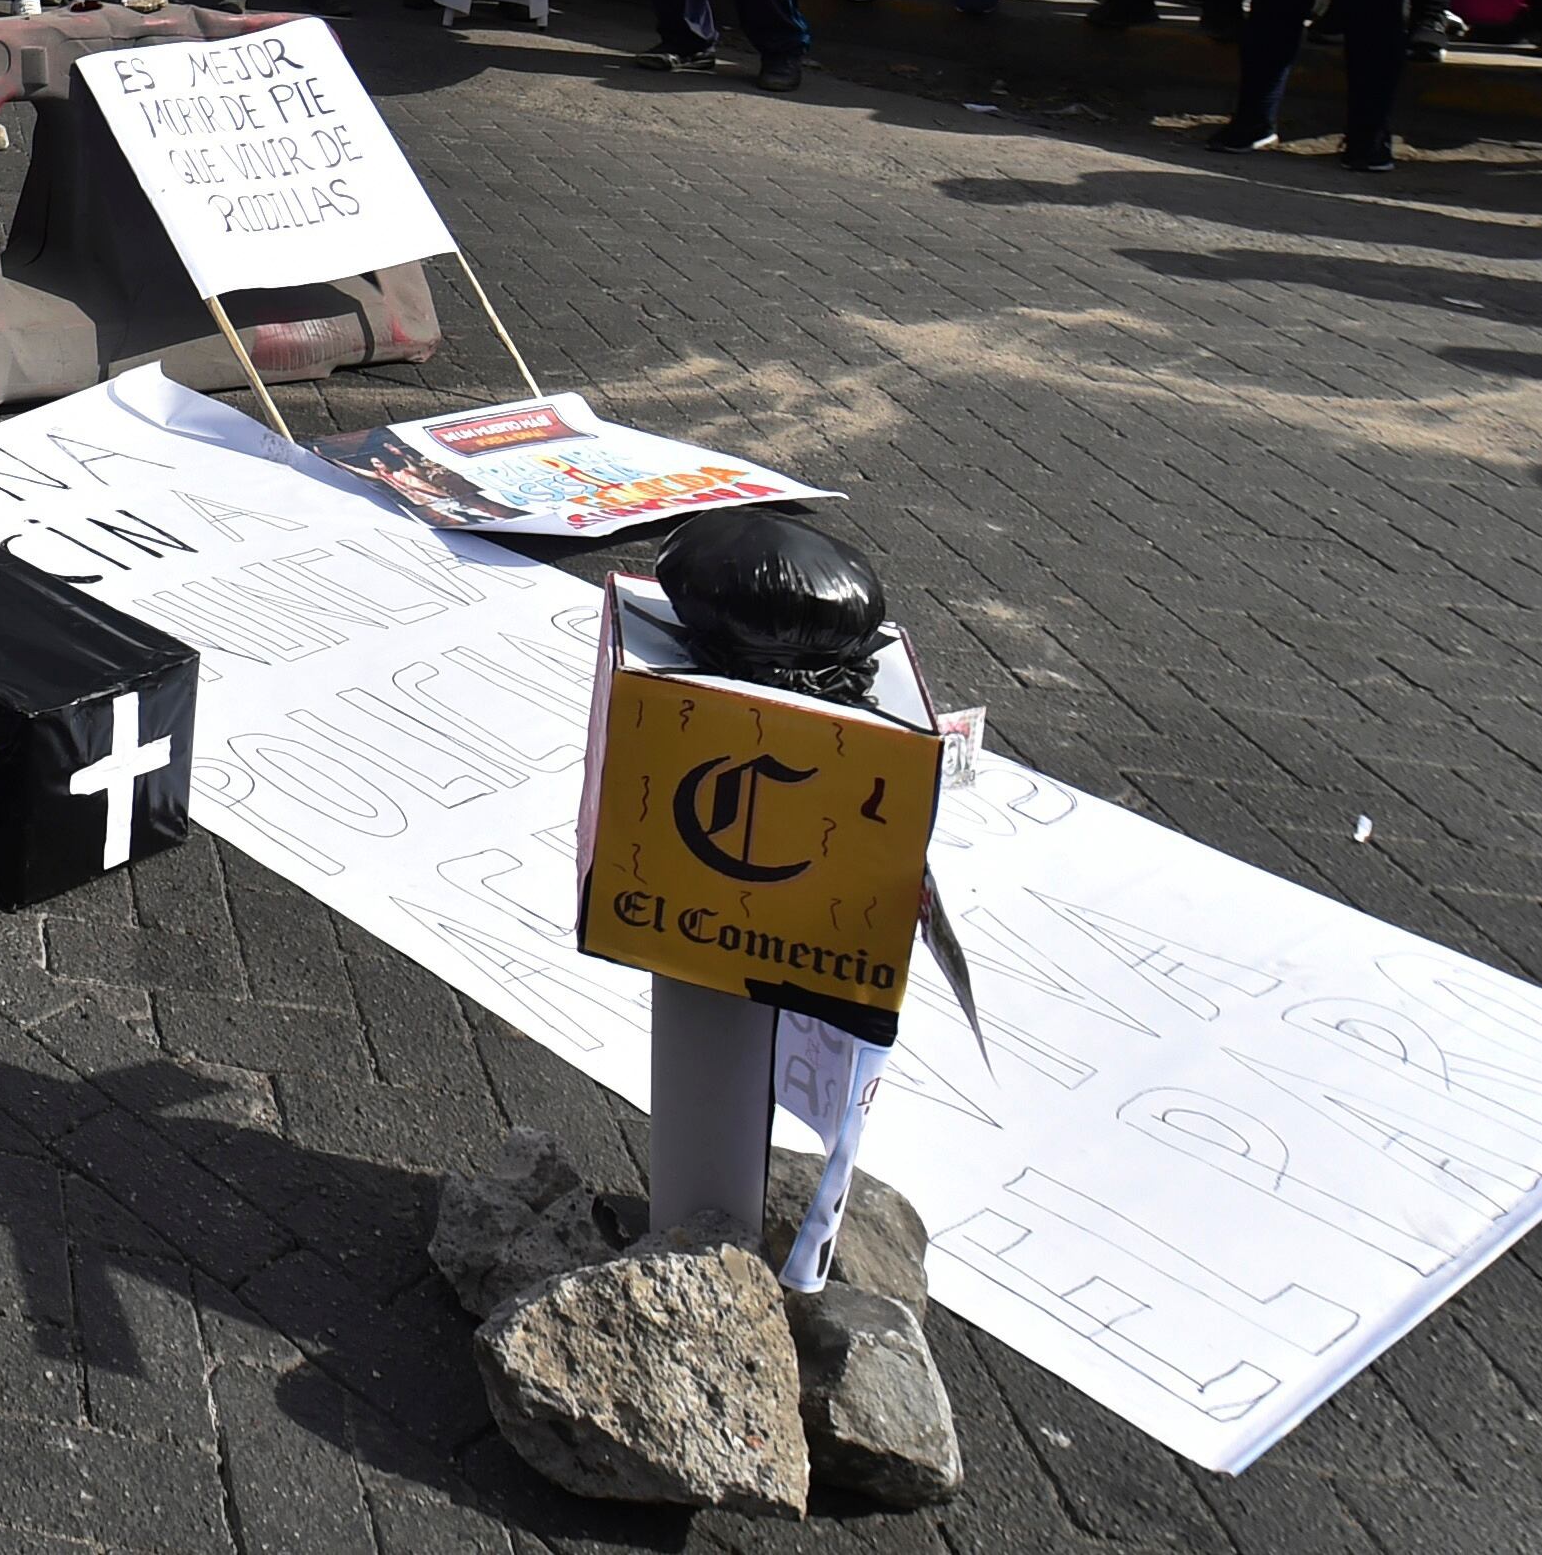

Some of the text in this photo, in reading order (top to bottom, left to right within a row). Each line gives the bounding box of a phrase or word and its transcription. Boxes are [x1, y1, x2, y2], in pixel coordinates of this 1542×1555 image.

[114, 38, 305, 95] ES MEJOR
[138, 77, 336, 138] MORIR DE PIE
[168, 124, 364, 186] QUE VIVIR DE
[208, 178, 362, 233] RODILLAS
[133, 529, 537, 684] NUNCIA
[191, 606, 606, 877] POLICIA
[672, 754, 819, 883] C
[613, 890, 896, 991] El Comercio
